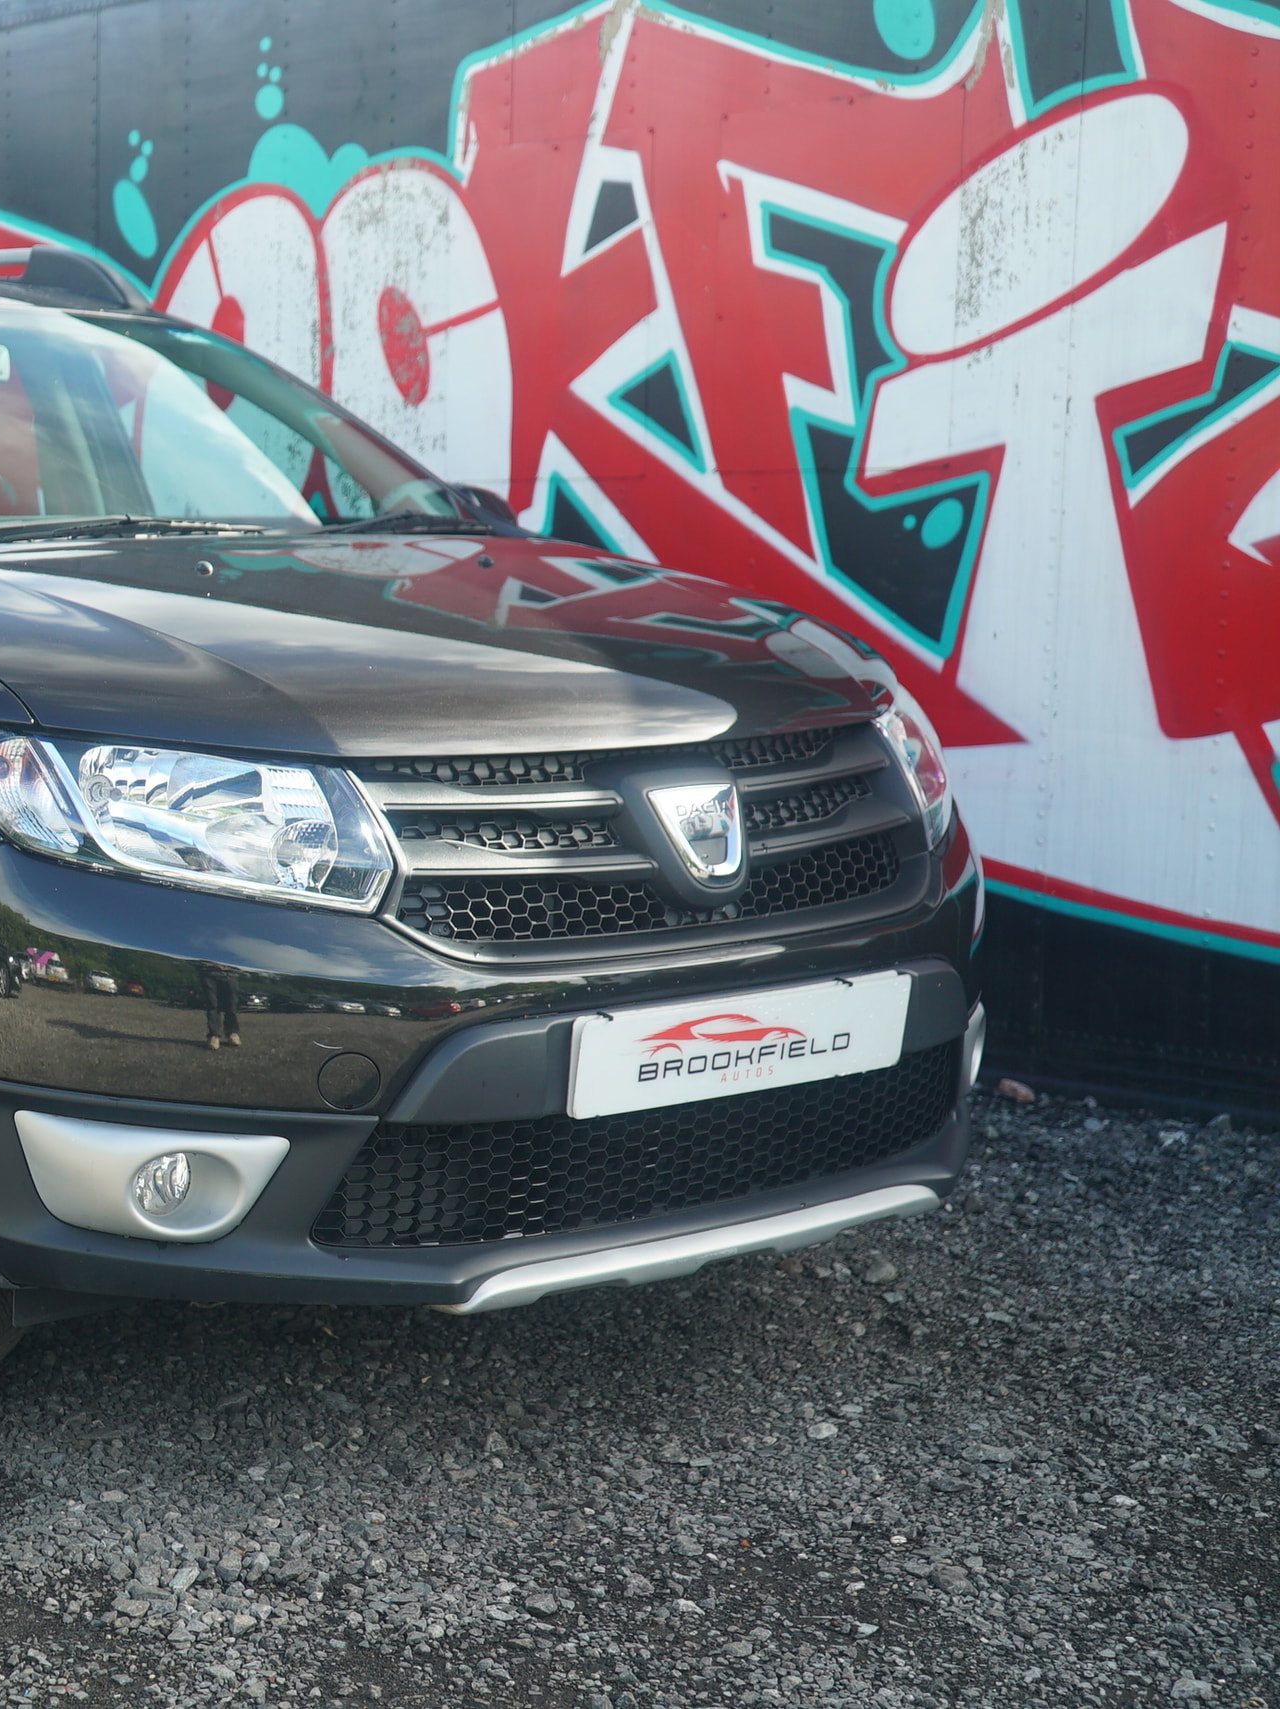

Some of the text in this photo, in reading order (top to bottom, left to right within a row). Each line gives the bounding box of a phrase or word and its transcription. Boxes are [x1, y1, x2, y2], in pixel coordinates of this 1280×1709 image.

[676, 799, 732, 817] DACIA
[637, 1032, 852, 1082] BROOKFIELD
[720, 1065, 775, 1083] AUTOS
